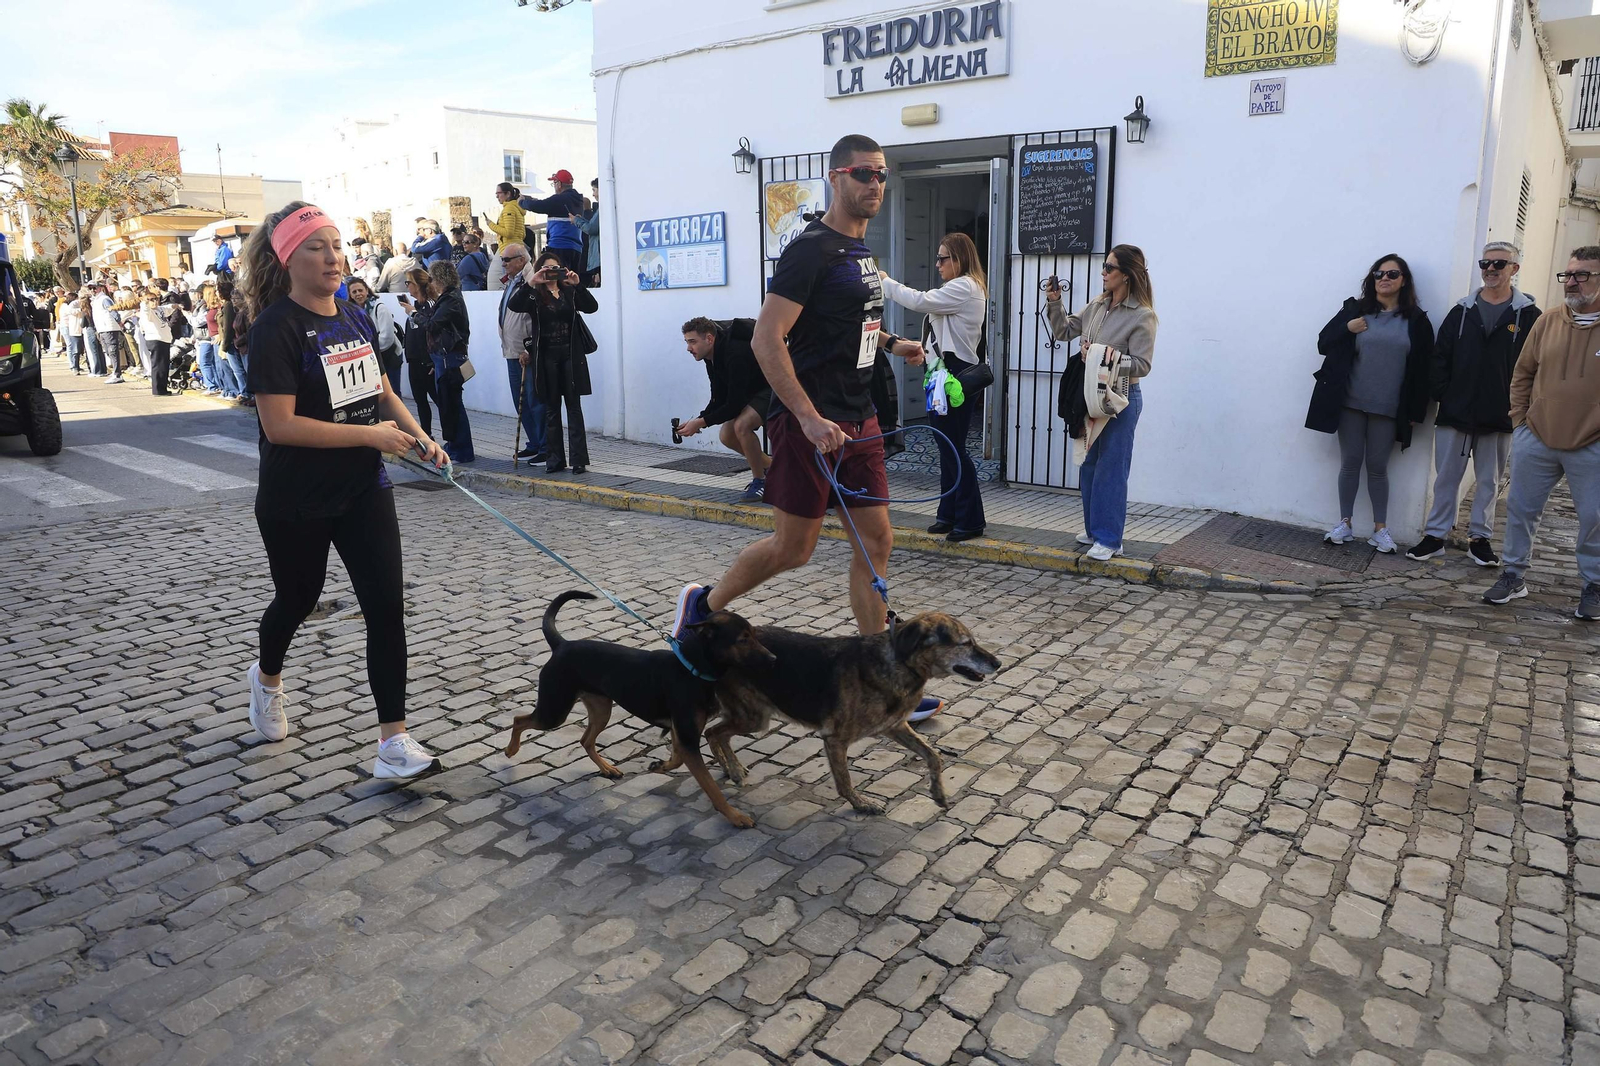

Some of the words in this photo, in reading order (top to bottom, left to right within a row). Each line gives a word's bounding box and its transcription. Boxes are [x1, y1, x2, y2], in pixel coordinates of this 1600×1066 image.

[1220, 1, 1299, 34] SANCHO
[1304, 0, 1323, 23] IV
[822, 2, 1002, 66] FREIDURIA
[1220, 35, 1246, 59] EL
[1251, 25, 1322, 56] BRAVO
[837, 66, 864, 95] LA
[884, 48, 988, 87] ALMENA
[1253, 83, 1282, 93] Arroyo
[1251, 101, 1282, 113] PAPEL
[1024, 148, 1094, 163] SUGERENCIAS
[651, 214, 723, 246] TERRAZA
[337, 360, 366, 390] 111
